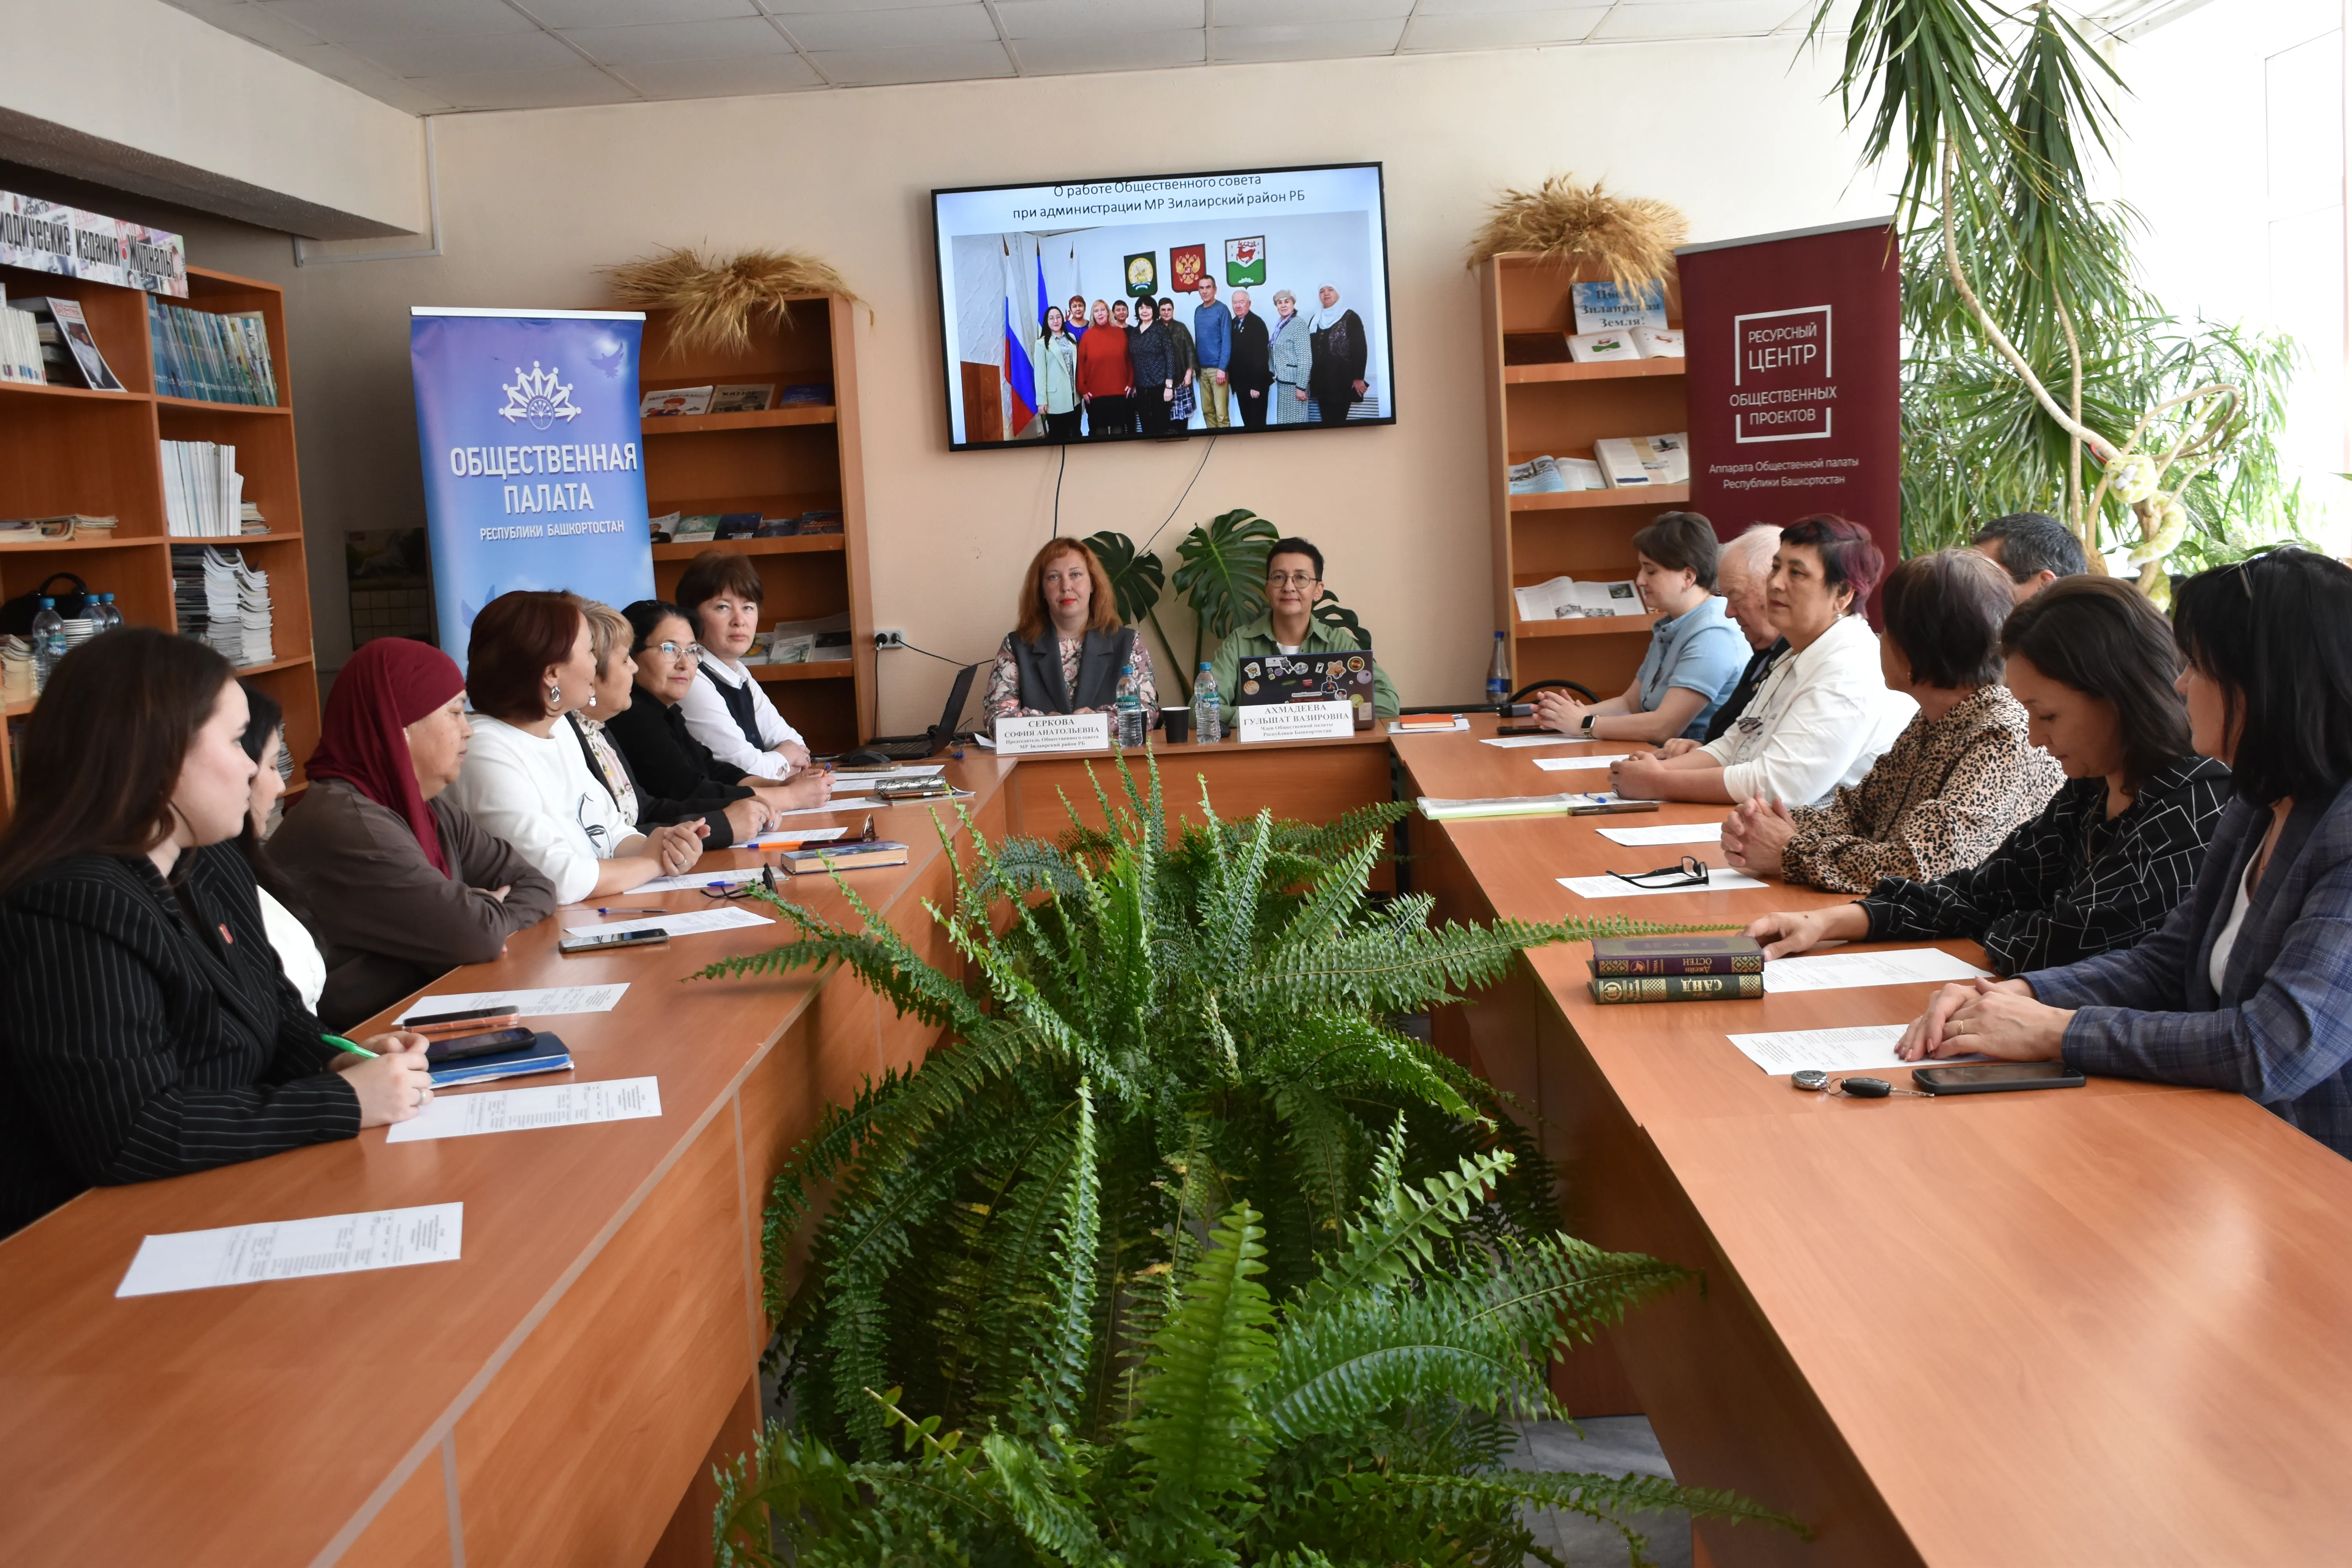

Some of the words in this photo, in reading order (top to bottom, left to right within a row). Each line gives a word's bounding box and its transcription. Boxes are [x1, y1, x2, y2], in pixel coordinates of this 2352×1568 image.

[1054, 186, 1063, 197] О
[1067, 185, 1112, 198] работе
[1114, 178, 1216, 193] Общественного
[1219, 176, 1261, 187] совета
[1013, 209, 1036, 220] при
[1040, 202, 1142, 219] администрации
[1145, 200, 1164, 210] МР
[1168, 194, 1244, 209] Зилаирский
[1247, 192, 1286, 205] район
[1290, 190, 1305, 201] РБ
[75, 228, 120, 267] издания
[127, 234, 175, 280] Журналы
[1600, 316, 1645, 327] Земля!
[1748, 322, 1817, 343] РЕСУРСНЫЙ
[1749, 344, 1817, 372] ЦЕНТР
[1730, 386, 1837, 407] ОБЩЕСТВЕННЫХ
[1749, 408, 1816, 425] ПРОЕКТОВ
[450, 443, 637, 479] ОБЩЕСТВЕННАЯ
[1709, 464, 1754, 474] Аппарата
[1755, 458, 1824, 471] Общественной
[1826, 458, 1859, 467] палаты
[1723, 478, 1779, 490] Республики
[1781, 475, 1845, 487] Башкортостан
[504, 483, 594, 514] ПАЛАТА
[480, 525, 543, 541] РЕСПУБЛИКИ
[548, 520, 624, 537] БАШКОРТОСТАН
[1265, 704, 1327, 714] АХМАДЕЕВА
[1028, 719, 1074, 728] СЕРКОВА
[1243, 716, 1290, 725] ГУЛЬШАТ
[1293, 713, 1349, 722] ВАЗИРОВНА
[1037, 727, 1099, 736] АНАТОЛЬЕВНА
[1685, 965, 1710, 973] Джейн
[1681, 978, 1723, 992] САНД
